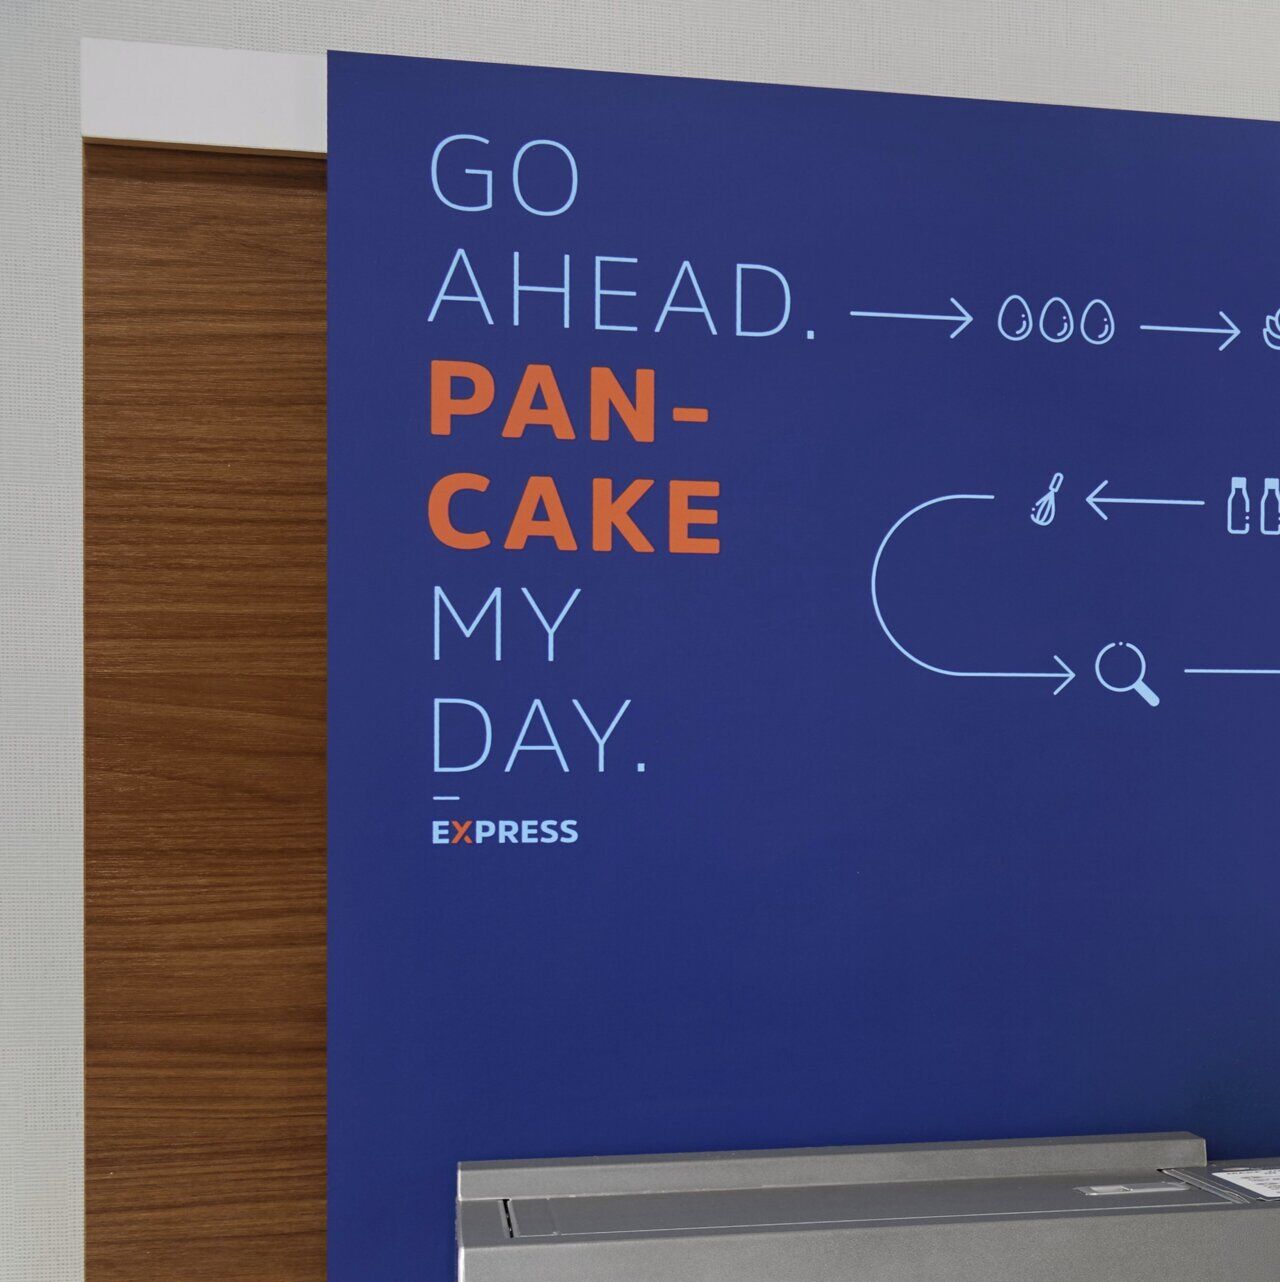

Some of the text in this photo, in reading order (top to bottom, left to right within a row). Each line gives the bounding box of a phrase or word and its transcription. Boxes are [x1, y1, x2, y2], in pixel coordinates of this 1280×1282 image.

[429, 133, 579, 216] GO
[427, 247, 816, 340] AHEAD.
[429, 358, 710, 444] PAN-
[427, 471, 722, 555] CAKE
[432, 585, 582, 663] MY
[432, 697, 647, 773] DAY.
[431, 818, 579, 845] EXPRESS
